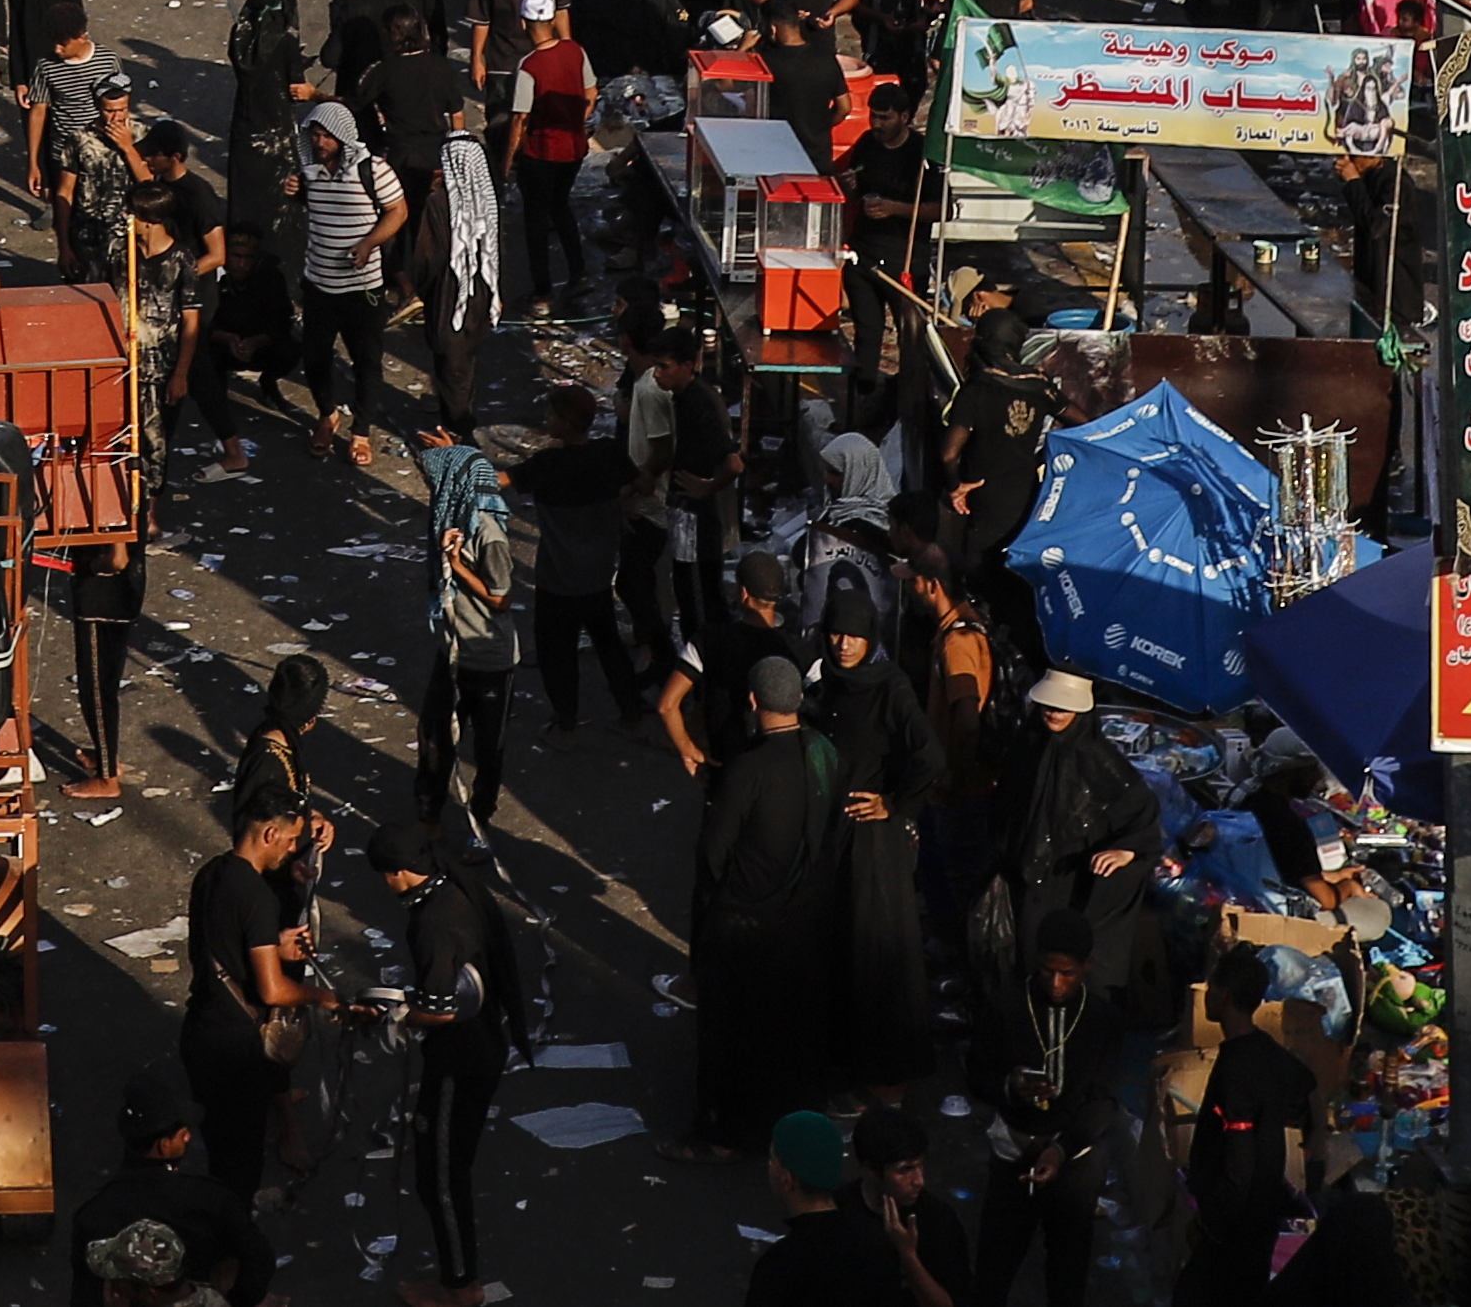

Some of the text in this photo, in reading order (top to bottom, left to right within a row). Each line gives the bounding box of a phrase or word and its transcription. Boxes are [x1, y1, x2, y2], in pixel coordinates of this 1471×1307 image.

[1103, 30, 1277, 69] موكب وهيئة
[1050, 71, 1320, 120] شباب المنتظر
[1060, 116, 1091, 131] ٢٠١٦
[1235, 126, 1278, 145] العمارة
[1057, 569, 1086, 620] KOREK
[1129, 634, 1187, 671] KOREK
